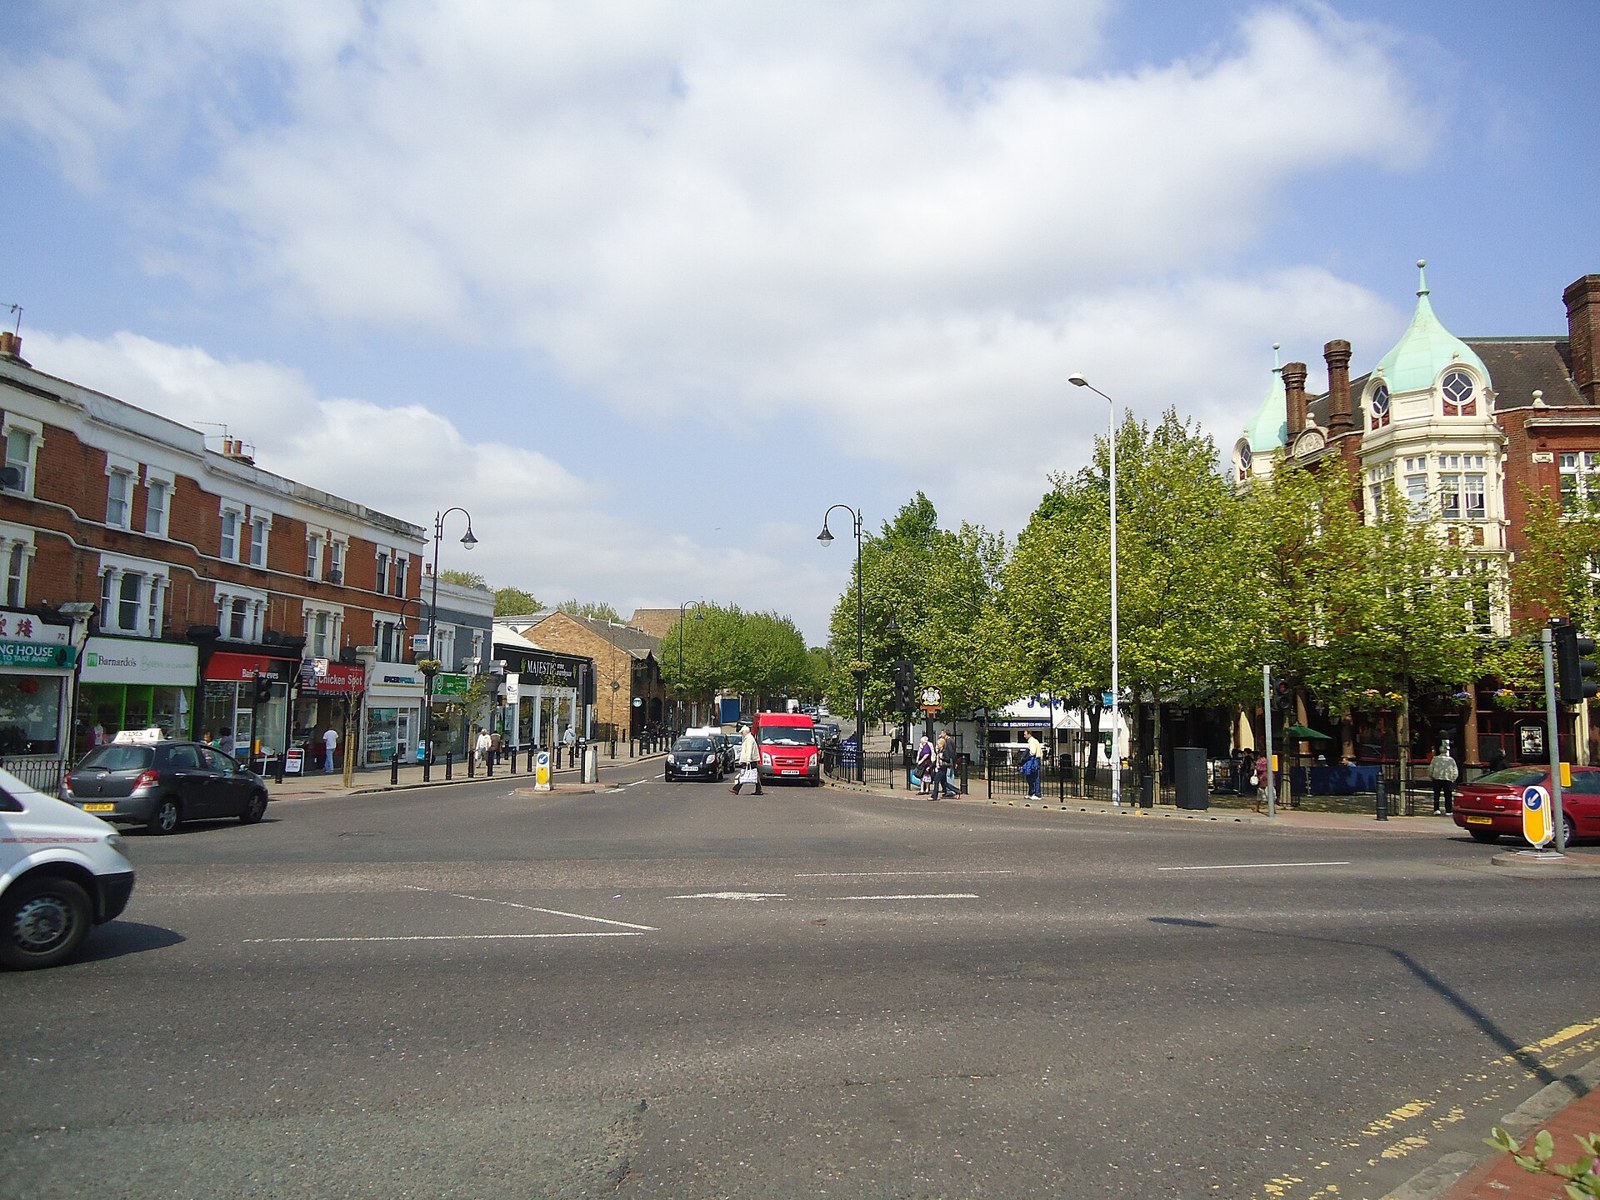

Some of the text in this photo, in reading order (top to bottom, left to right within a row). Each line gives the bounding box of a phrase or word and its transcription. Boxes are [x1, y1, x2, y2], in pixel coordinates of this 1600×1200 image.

[16, 645, 54, 657] HOUSE
[98, 656, 137, 667] Barnardo's
[347, 674, 363, 686] Spot
